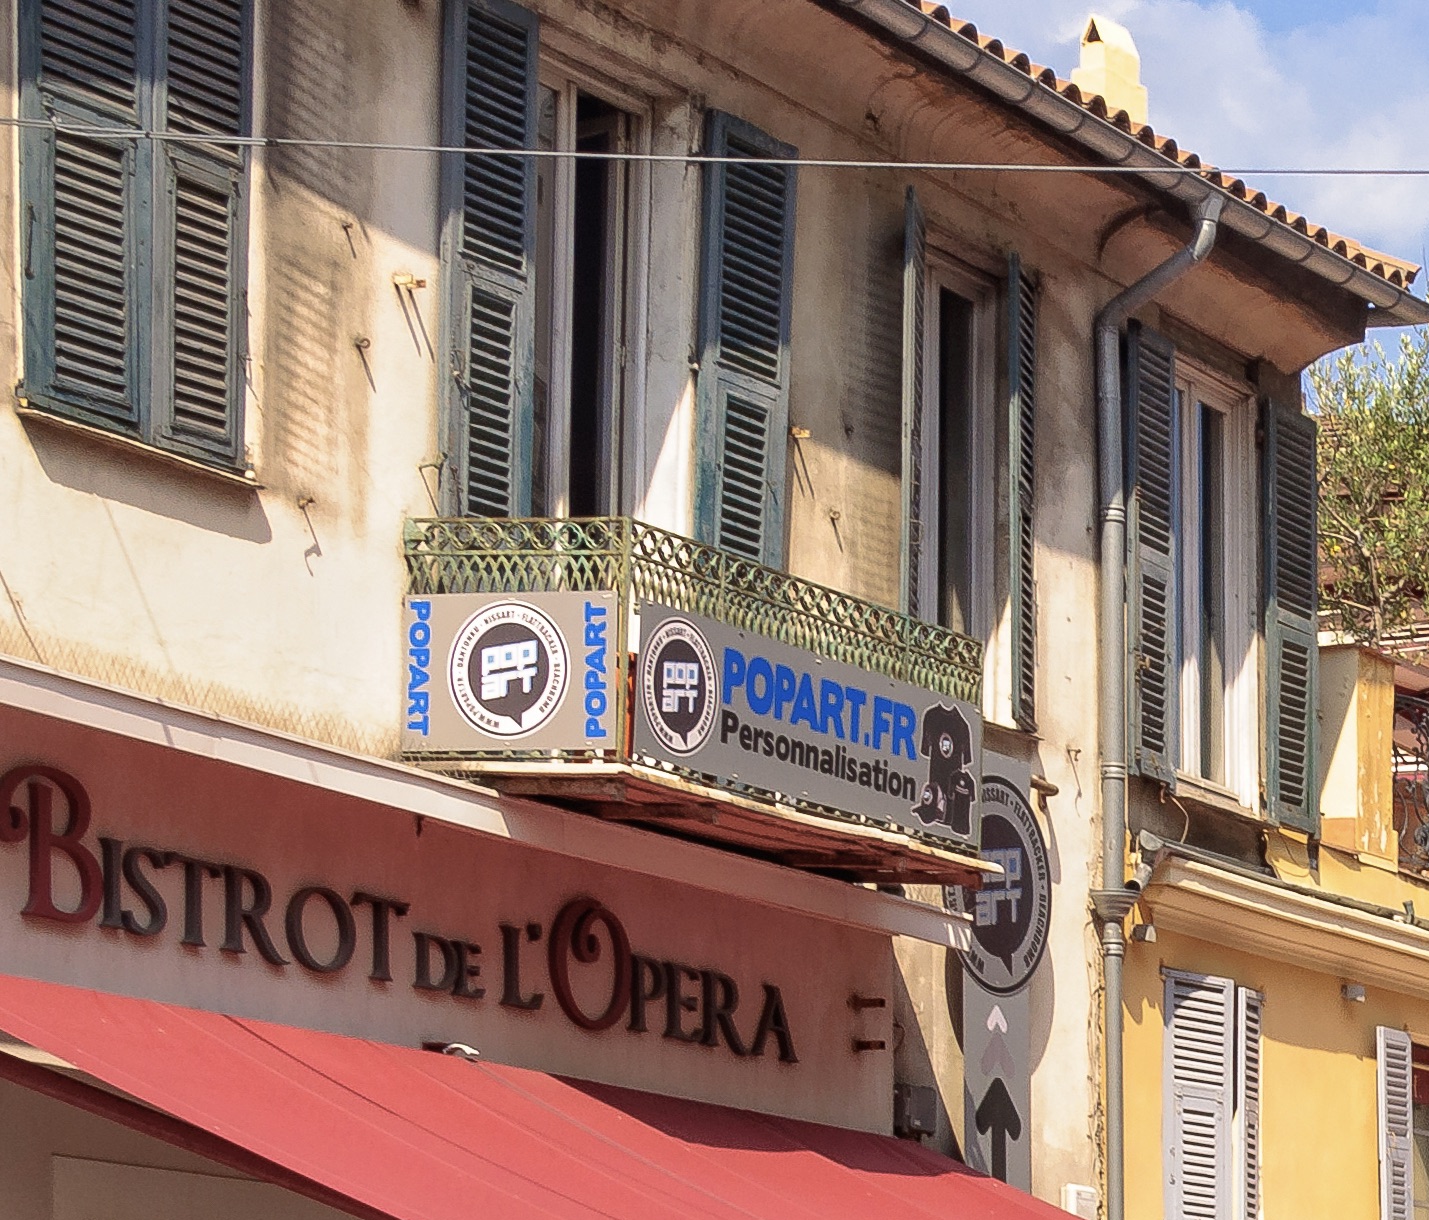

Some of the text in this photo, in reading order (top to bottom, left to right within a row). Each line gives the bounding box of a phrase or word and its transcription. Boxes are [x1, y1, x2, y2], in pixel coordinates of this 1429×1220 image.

[407, 600, 431, 736] POPART
[584, 601, 607, 738] POPART
[722, 647, 918, 761] POPART.FR
[720, 708, 917, 802] Personnalisation
